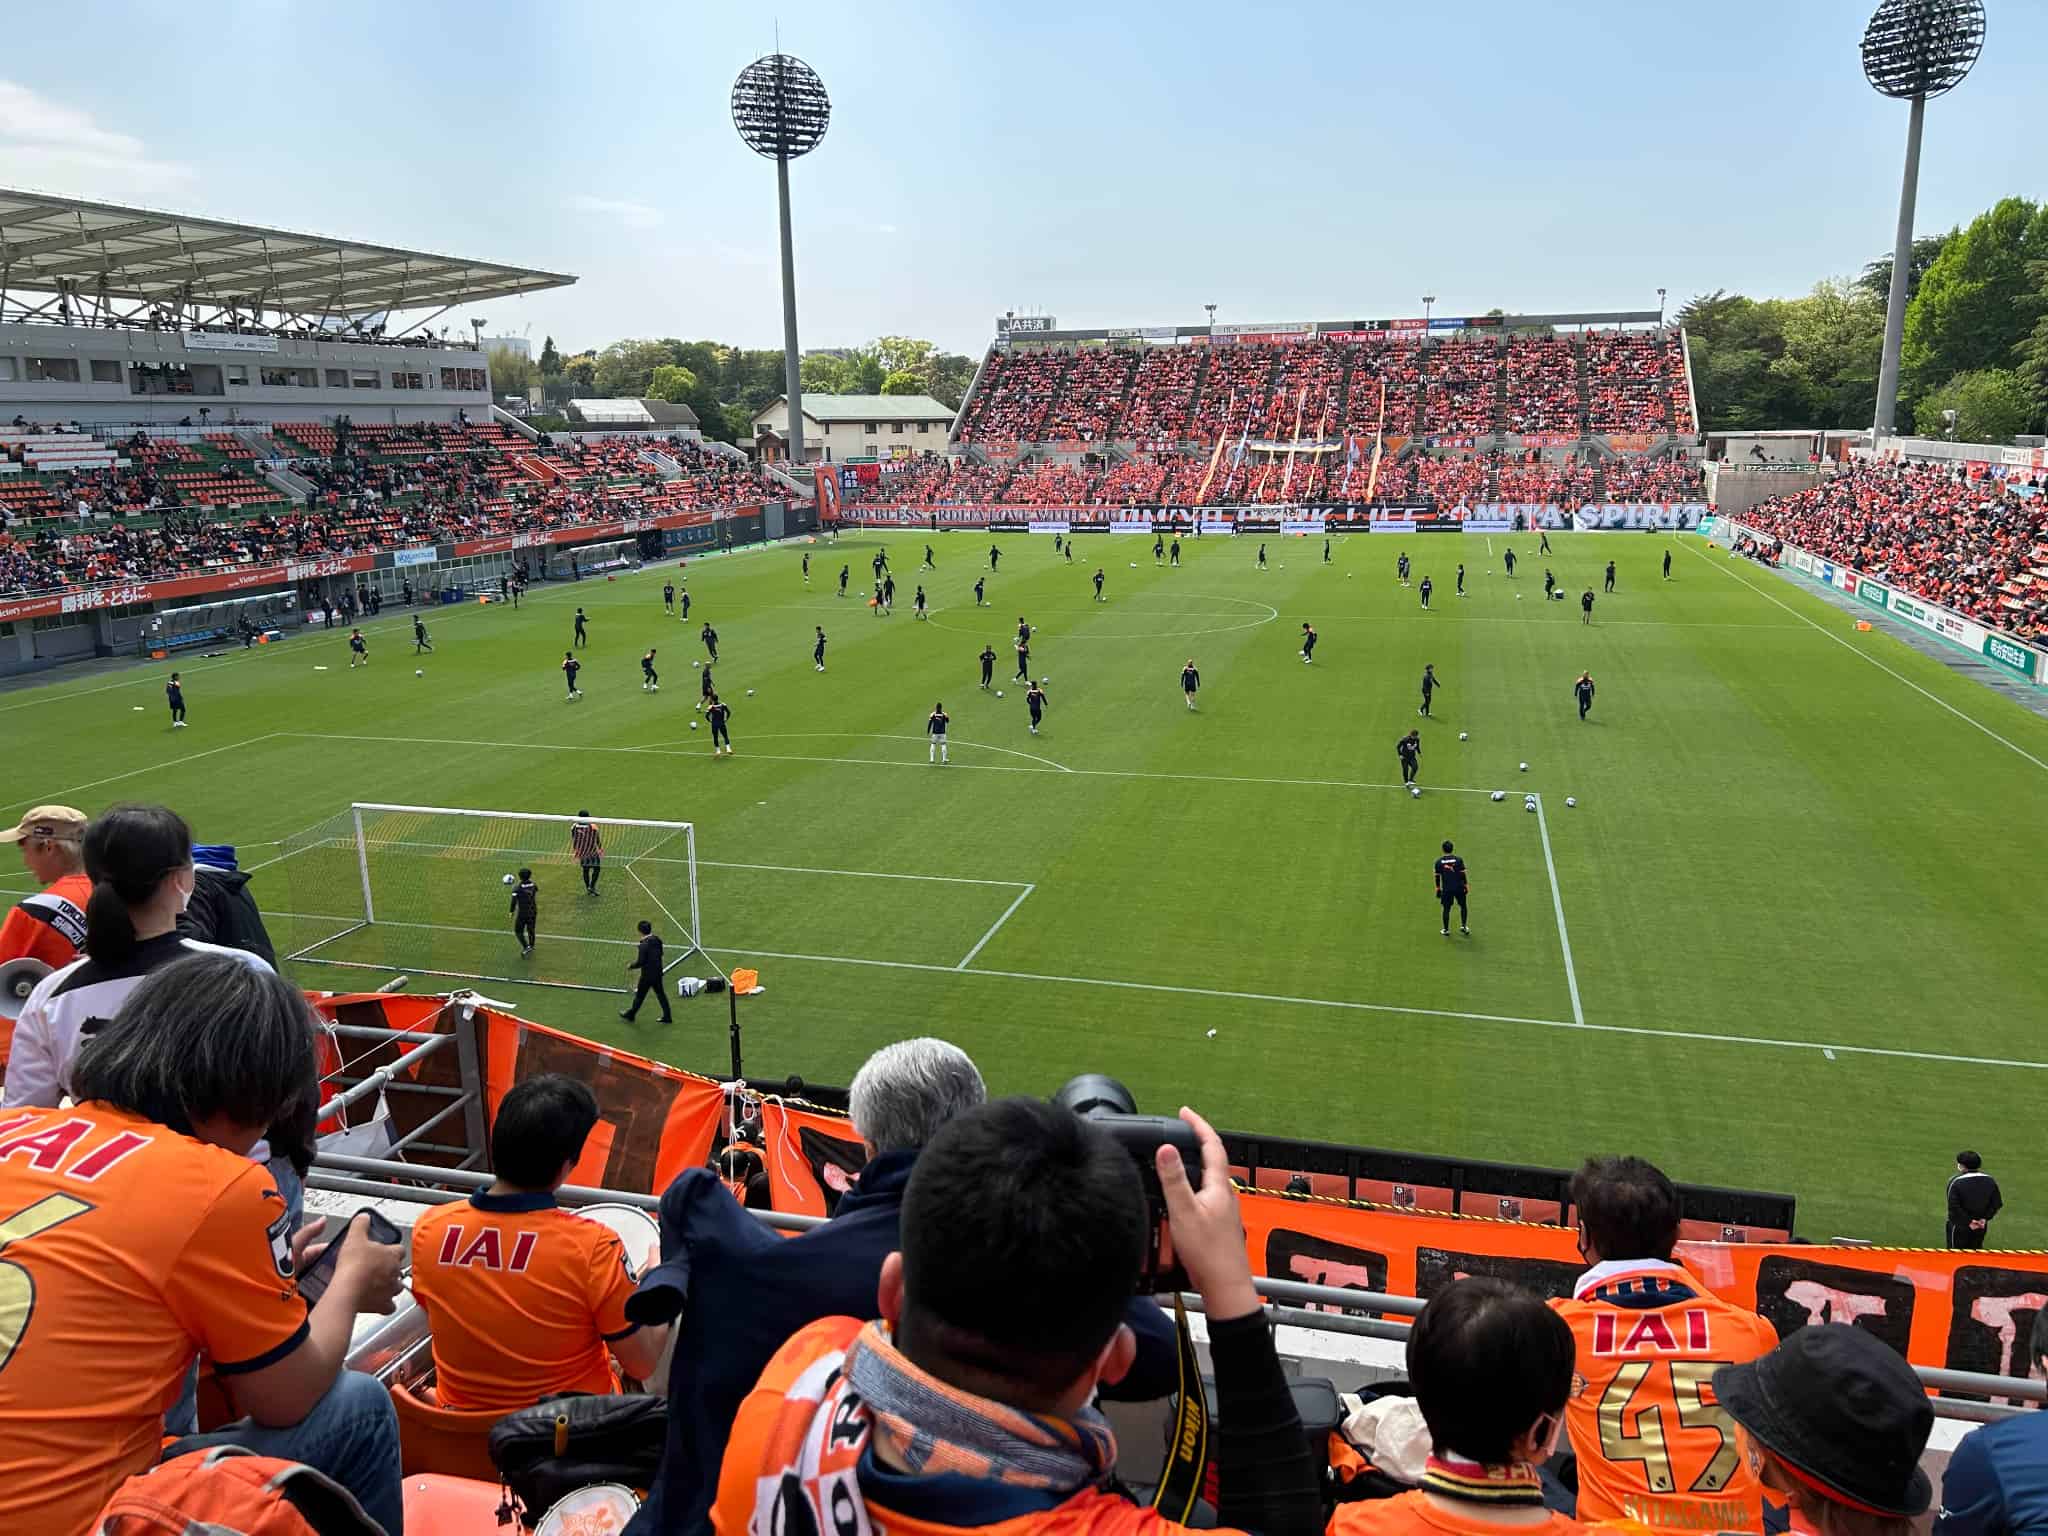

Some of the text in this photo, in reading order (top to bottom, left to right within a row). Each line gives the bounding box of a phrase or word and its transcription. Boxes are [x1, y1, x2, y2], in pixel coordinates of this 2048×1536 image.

[874, 507, 922, 521] BLESS
[1578, 503, 1706, 529] SPIRIT
[438, 1224, 539, 1273] IAI
[1592, 1309, 1710, 1357] IAI
[1179, 1395, 1201, 1463] Nikon
[1597, 1360, 1742, 1494] 45
